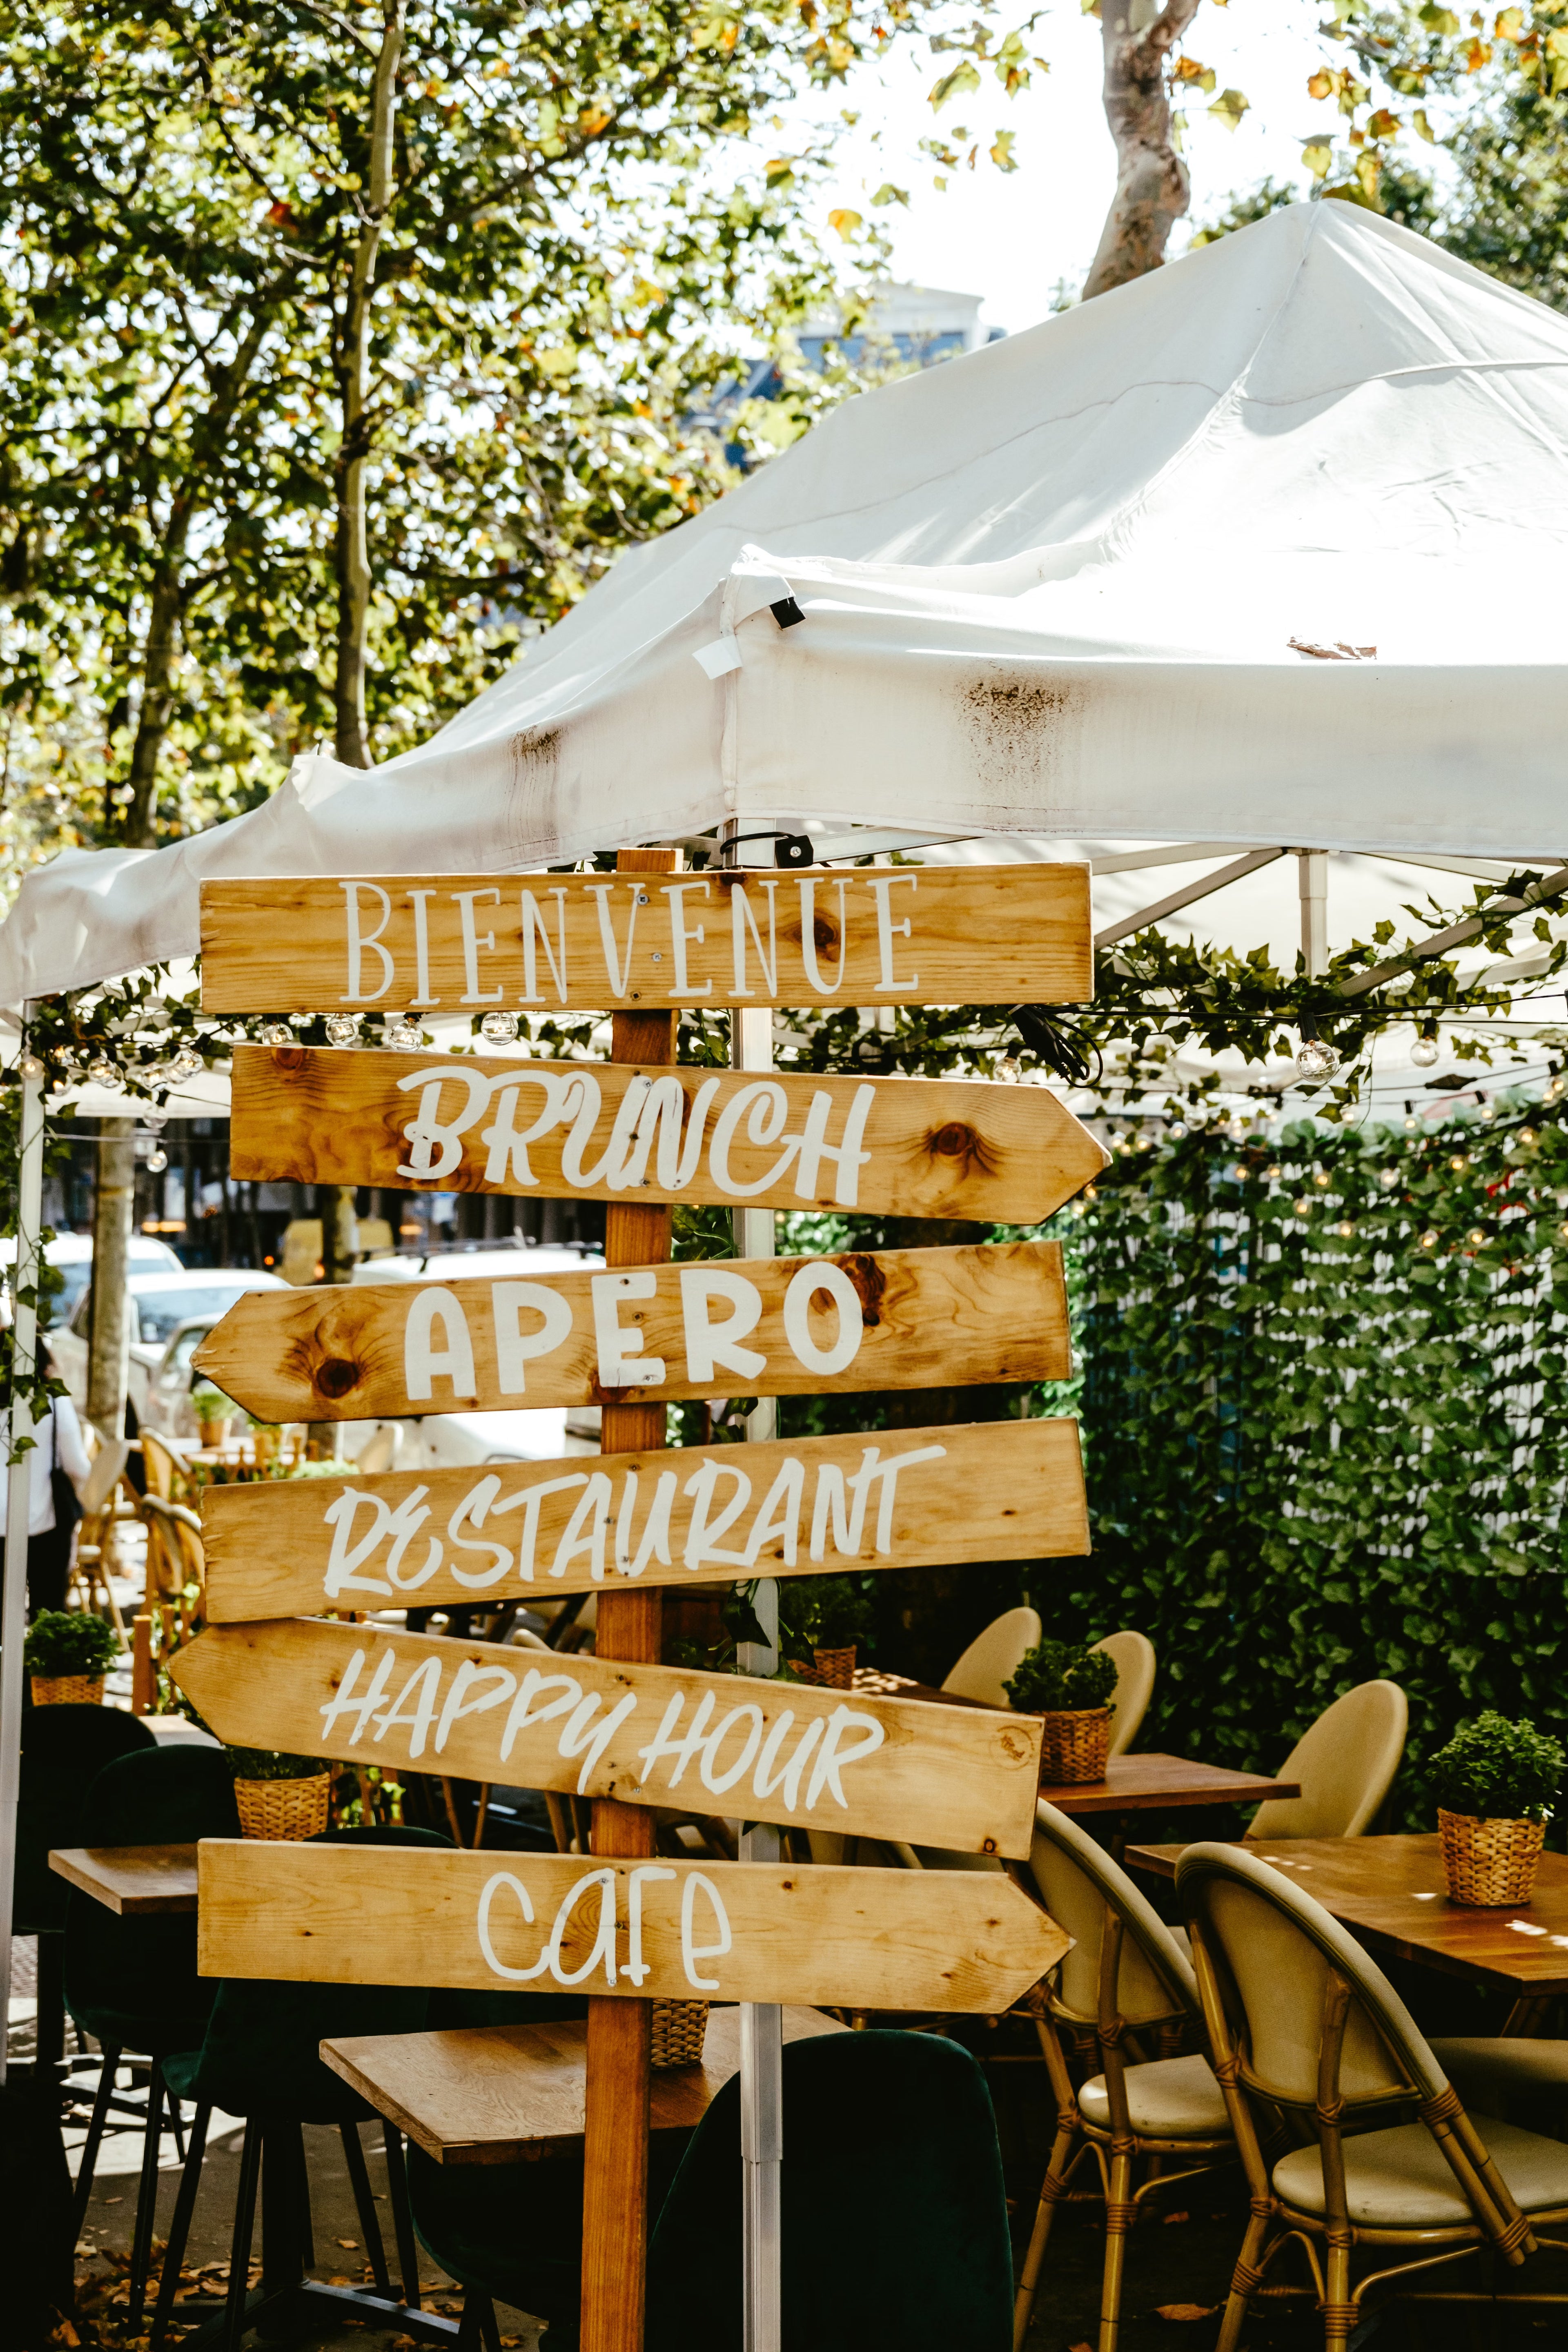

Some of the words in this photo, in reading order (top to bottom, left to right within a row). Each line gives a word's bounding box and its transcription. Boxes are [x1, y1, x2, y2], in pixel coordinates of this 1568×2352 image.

[339, 874, 919, 1005] BIENVENUE
[397, 1065, 875, 1207] BRUNCH
[404, 1261, 863, 1400] APERO
[323, 1445, 947, 1598] RESTAURANT
[319, 1648, 637, 1794] HAPPY
[637, 1690, 884, 1811] HOUR
